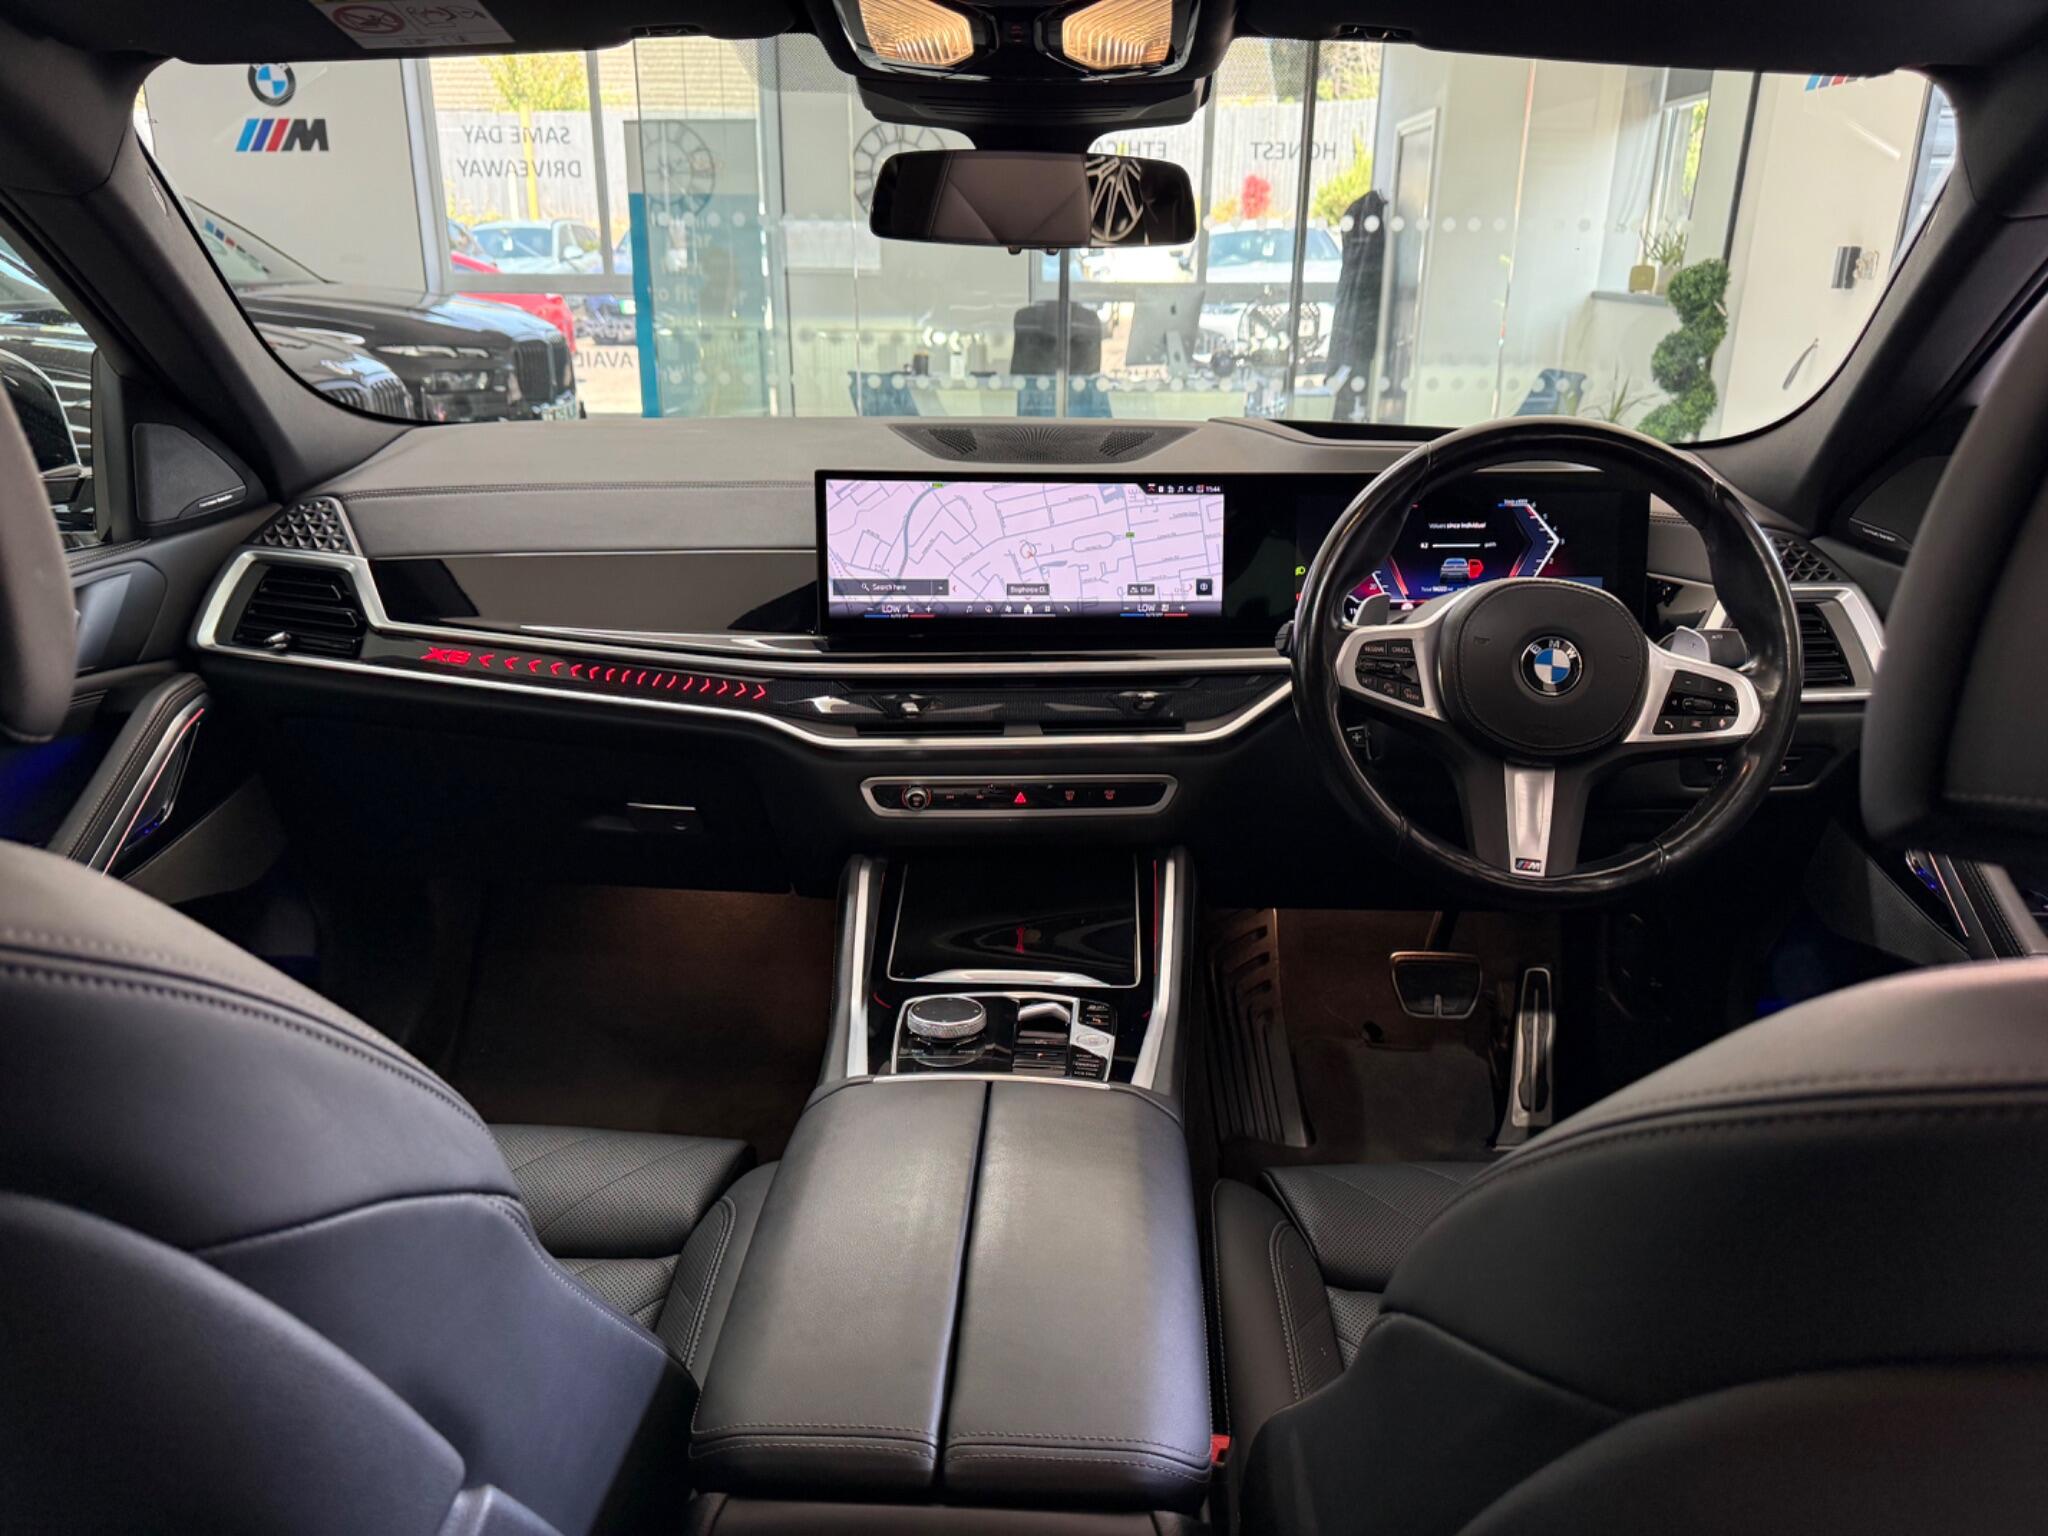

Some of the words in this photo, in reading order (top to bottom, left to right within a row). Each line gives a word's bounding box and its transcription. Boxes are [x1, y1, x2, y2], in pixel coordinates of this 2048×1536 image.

[881, 604, 900, 613] LOW
[1137, 604, 1156, 612] LOW
[1529, 639, 1578, 659] BMW
